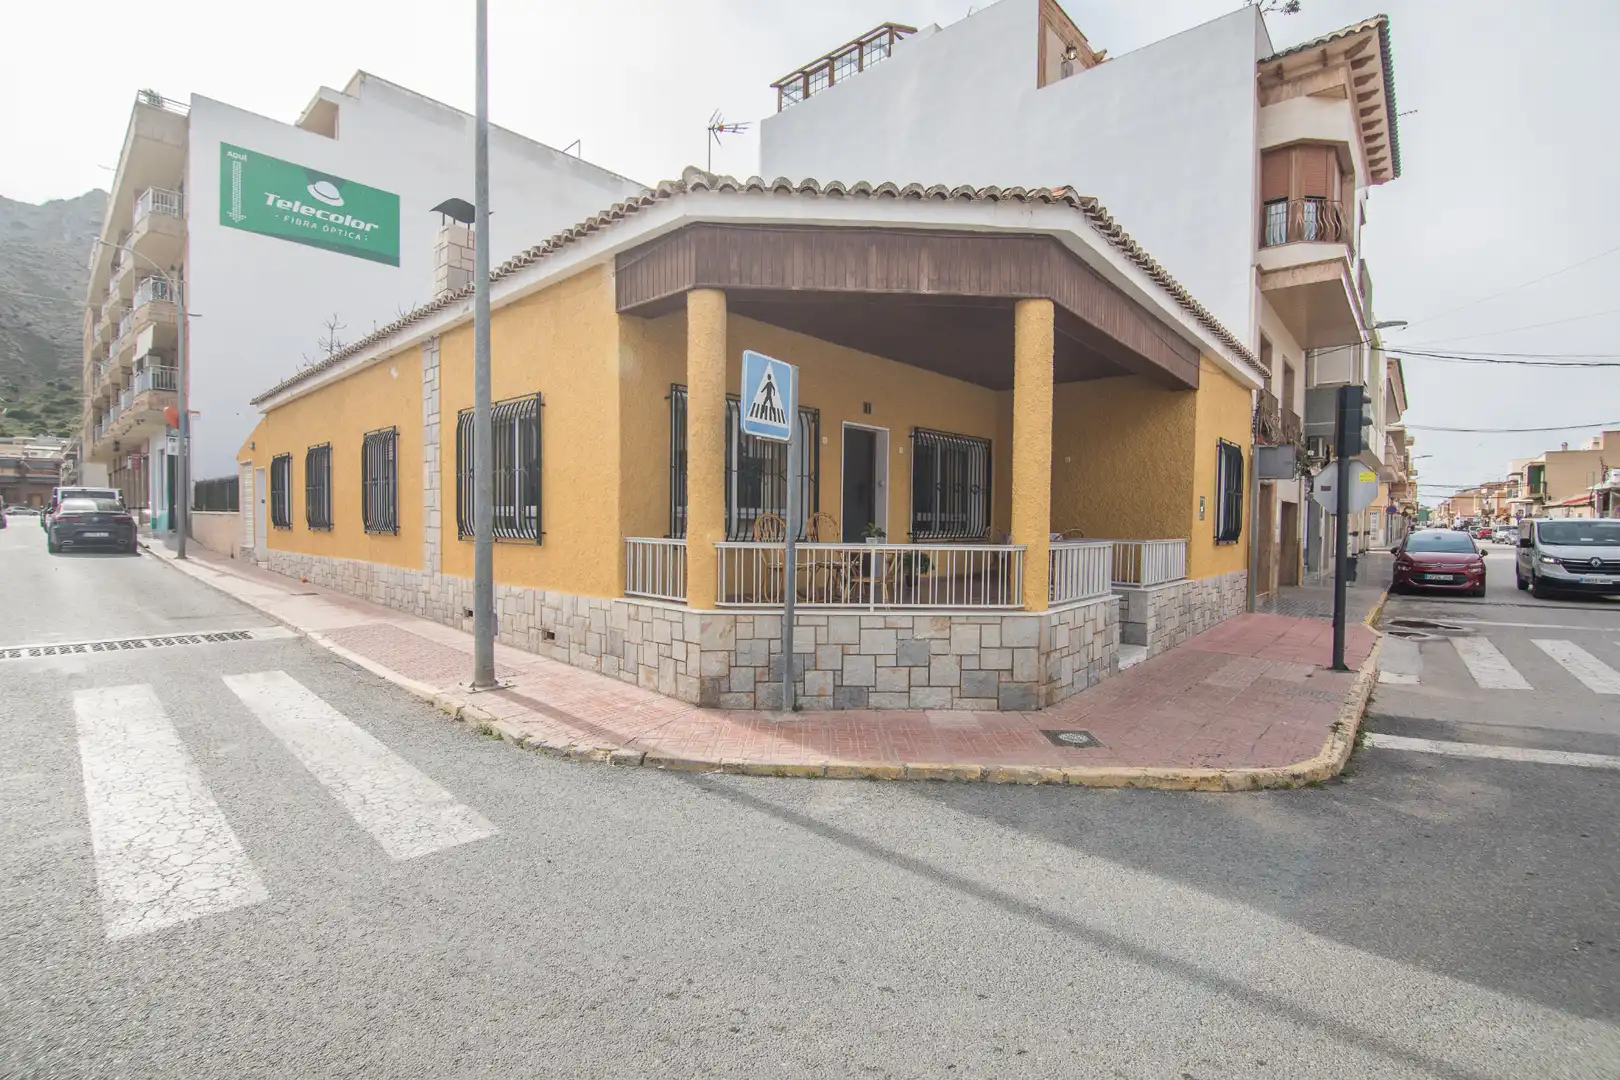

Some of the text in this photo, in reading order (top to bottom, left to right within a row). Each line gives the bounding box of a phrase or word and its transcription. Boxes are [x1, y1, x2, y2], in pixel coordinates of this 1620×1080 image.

[264, 192, 379, 232] Telecolor
[283, 214, 361, 241] FIBRA ÓPTICA
